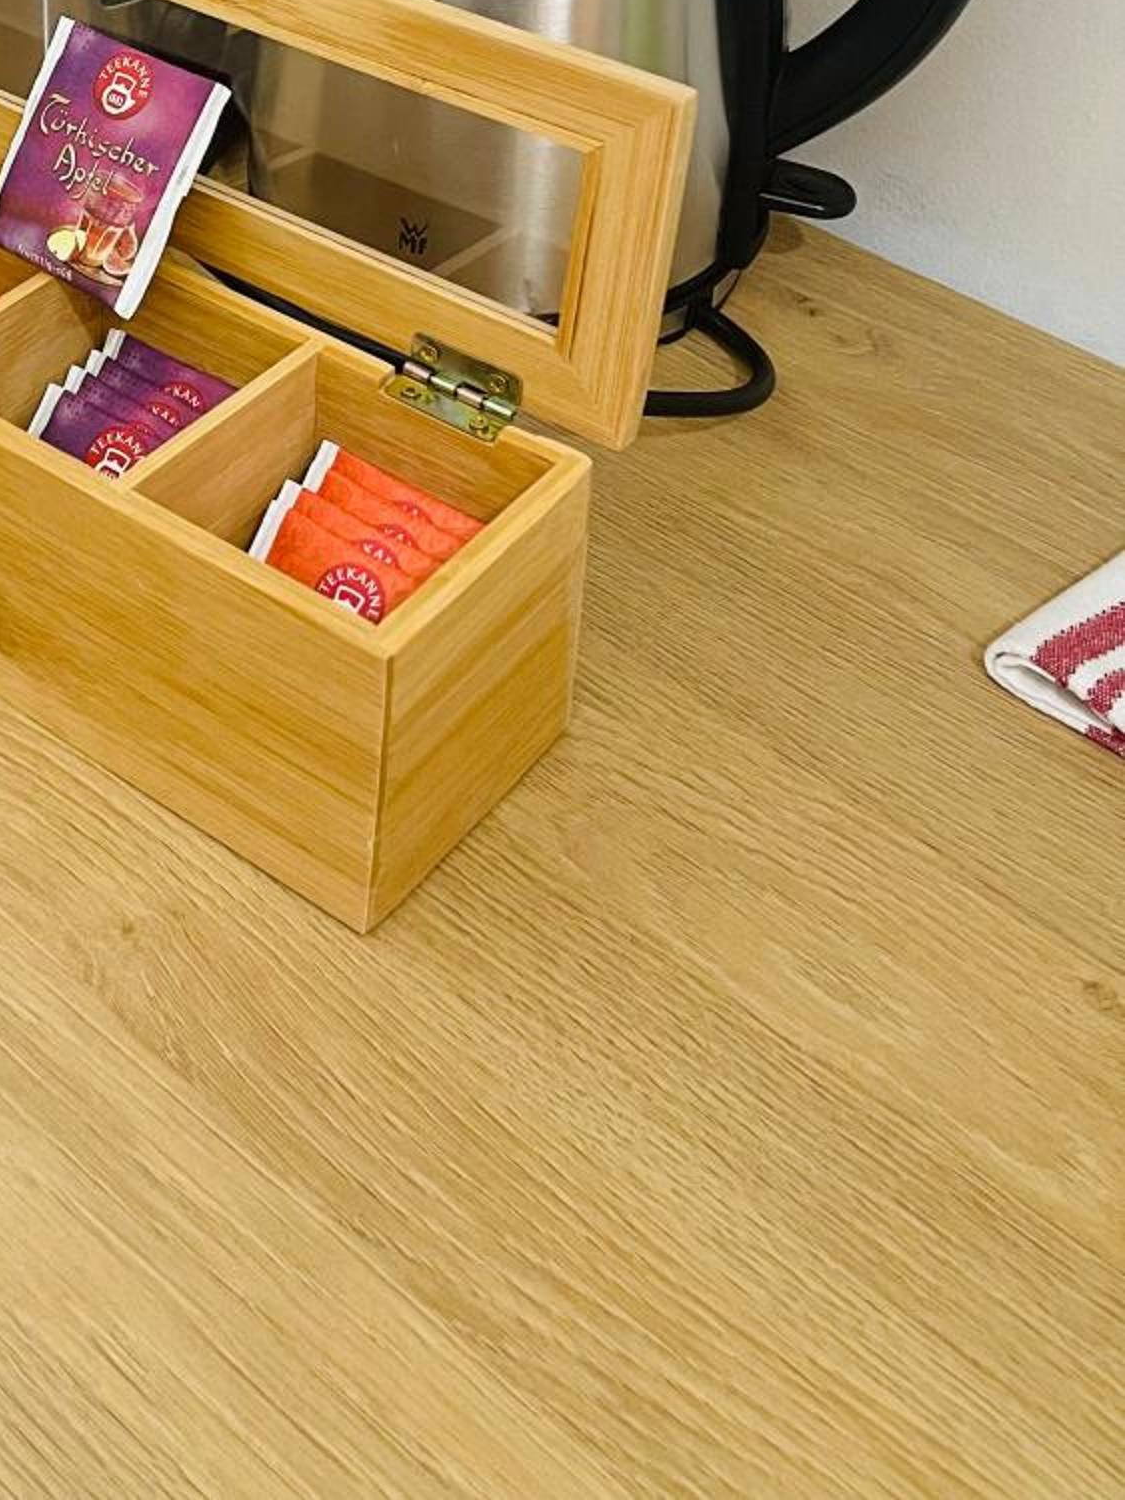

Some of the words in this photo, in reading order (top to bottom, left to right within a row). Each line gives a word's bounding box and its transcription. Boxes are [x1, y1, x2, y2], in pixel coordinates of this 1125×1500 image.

[98, 56, 151, 99] TEEKANNE
[40, 93, 160, 176] Türkischer
[53, 143, 115, 199] Apfel
